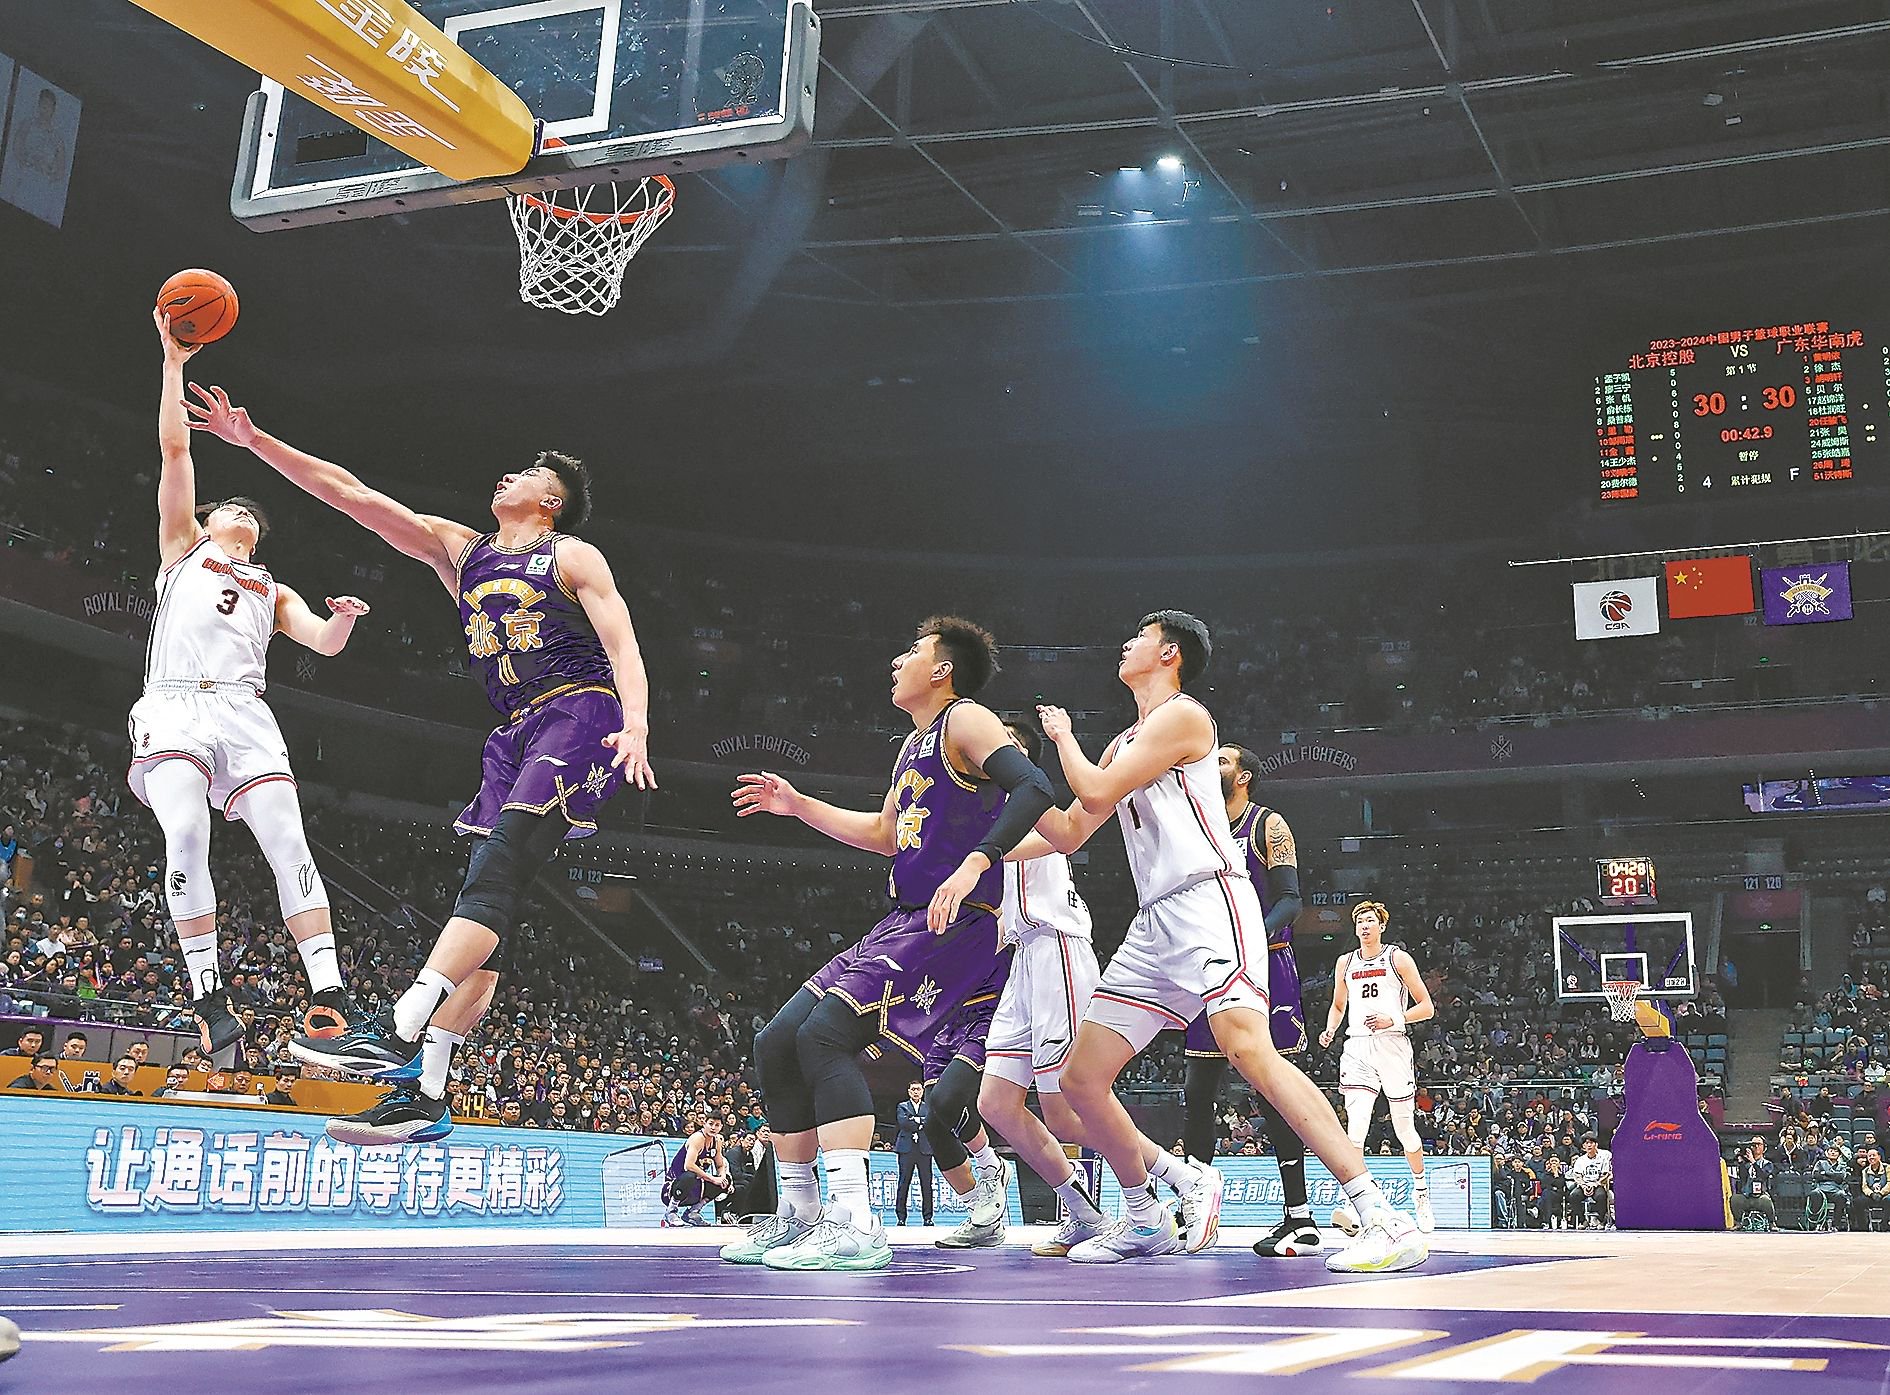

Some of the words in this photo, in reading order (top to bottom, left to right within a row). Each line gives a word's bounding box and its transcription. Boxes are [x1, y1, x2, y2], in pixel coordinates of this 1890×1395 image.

[1730, 344, 1749, 358] VS
[1776, 330, 1864, 355] 广东华南虎
[1628, 349, 1695, 370] 北京控股
[1693, 392, 1727, 417] 30
[1762, 385, 1796, 410] 30
[1721, 425, 1773, 442] 00:42.9
[1702, 475, 1712, 488] 4
[1731, 473, 1772, 487] 累计犯规
[1789, 467, 1800, 481] F
[83, 591, 122, 617] ROYAL
[216, 589, 239, 615] 3
[465, 609, 545, 659] 北京
[712, 735, 750, 758] ROYAL
[754, 734, 810, 765] FIGHTERS
[1260, 749, 1297, 775] ROYAL
[1301, 746, 1357, 771] FIGHTERS
[588, 869, 602, 883] 123
[1744, 876, 1759, 890] 121
[1312, 893, 1327, 904] 122
[1332, 892, 1346, 904] 121
[1361, 982, 1379, 999] 26
[1643, 1133, 1683, 1141] LI-NING
[86, 1125, 566, 1215] 让通话前的等待更精彩
